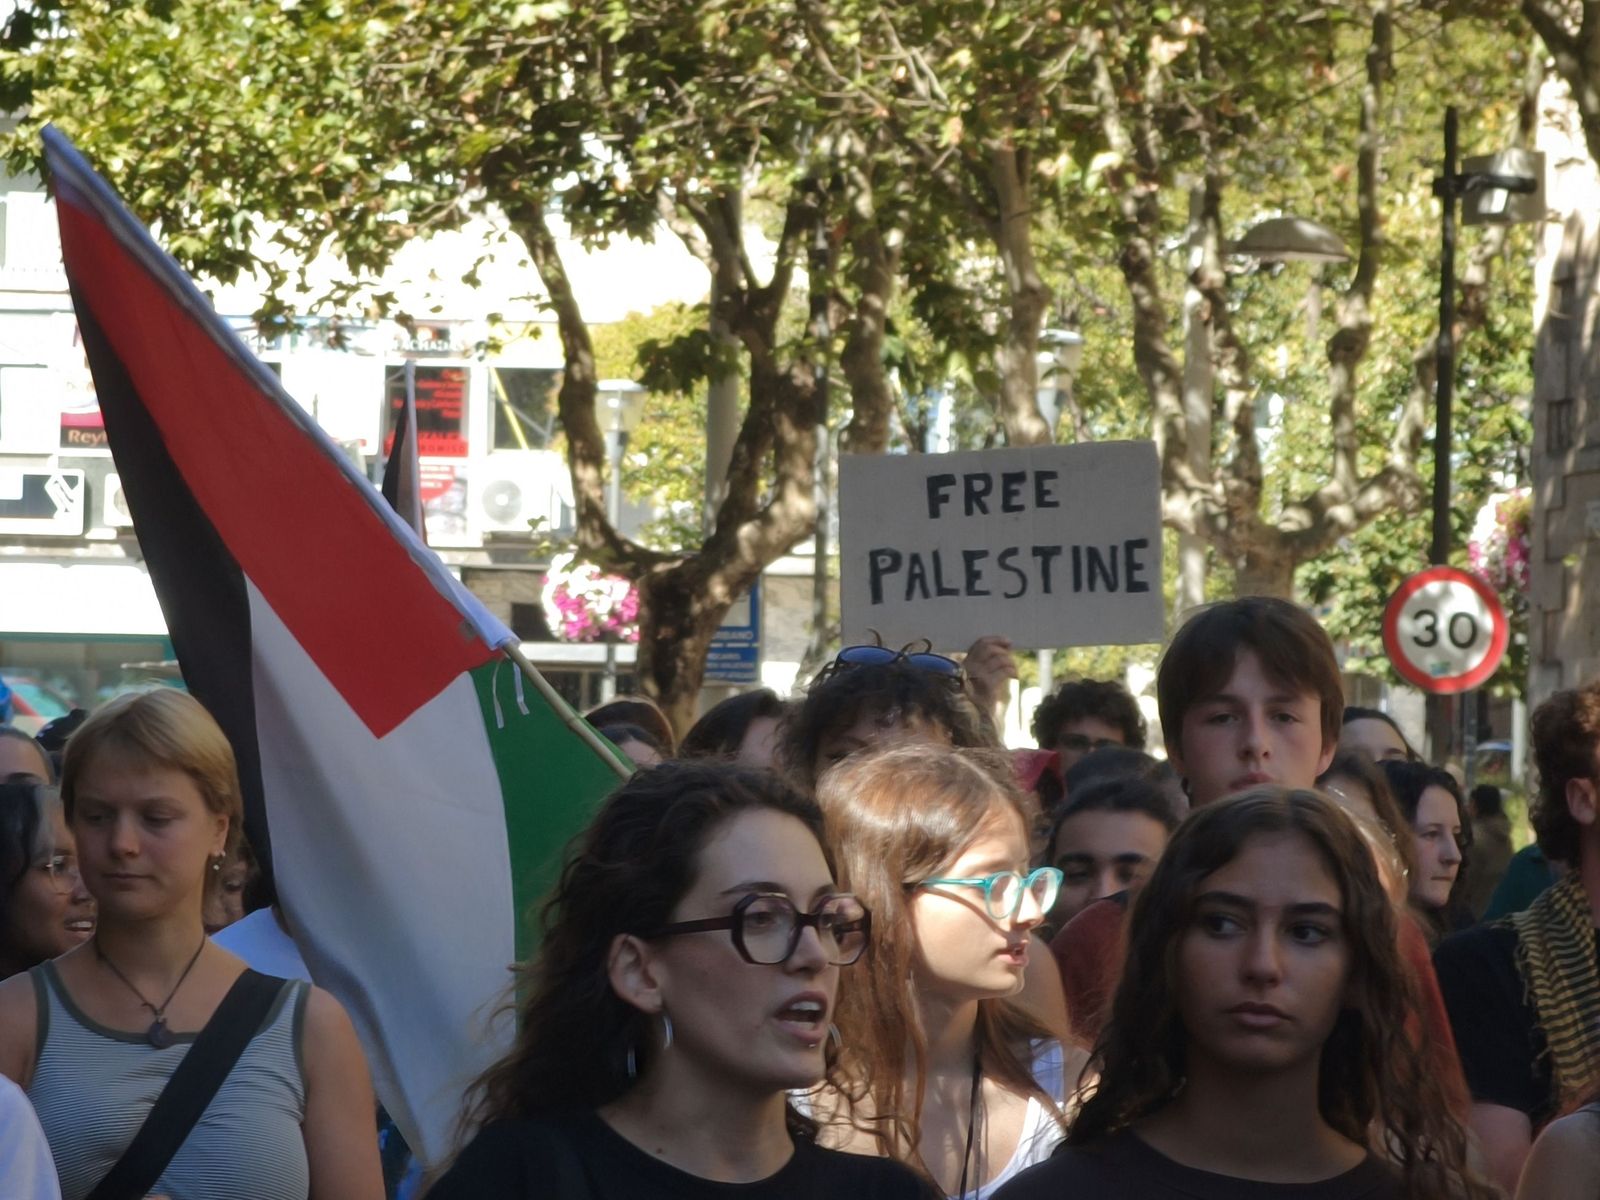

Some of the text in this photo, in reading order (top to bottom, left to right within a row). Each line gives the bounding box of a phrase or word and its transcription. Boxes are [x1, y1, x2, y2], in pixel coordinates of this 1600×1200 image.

[926, 470, 1060, 519] FREE
[869, 538, 1150, 605] PALESTINE
[1413, 609, 1478, 649] 30
